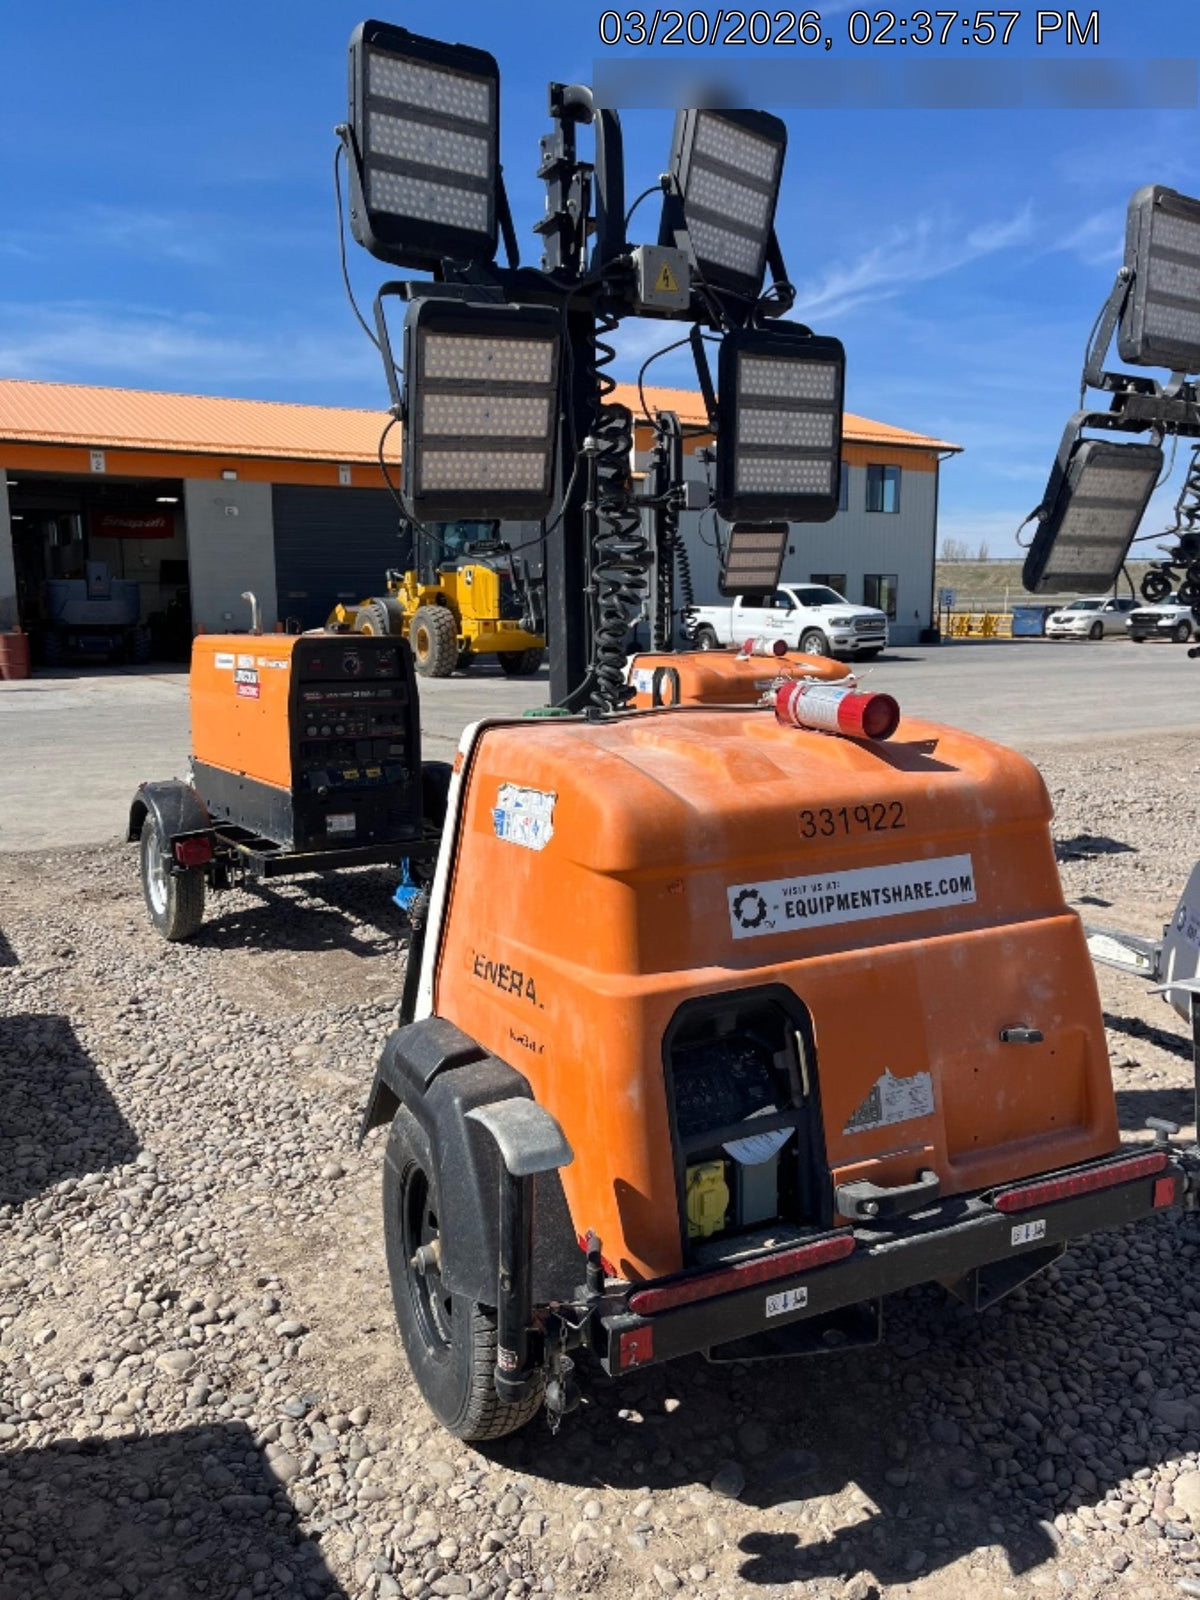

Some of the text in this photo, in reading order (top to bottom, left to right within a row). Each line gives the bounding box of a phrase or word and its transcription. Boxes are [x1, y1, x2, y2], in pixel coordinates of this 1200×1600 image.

[800, 801, 906, 838] 331922
[781, 885, 807, 896] VISIT
[810, 882, 823, 893] US
[785, 875, 972, 919] EQUIPMENTSHARE.COM
